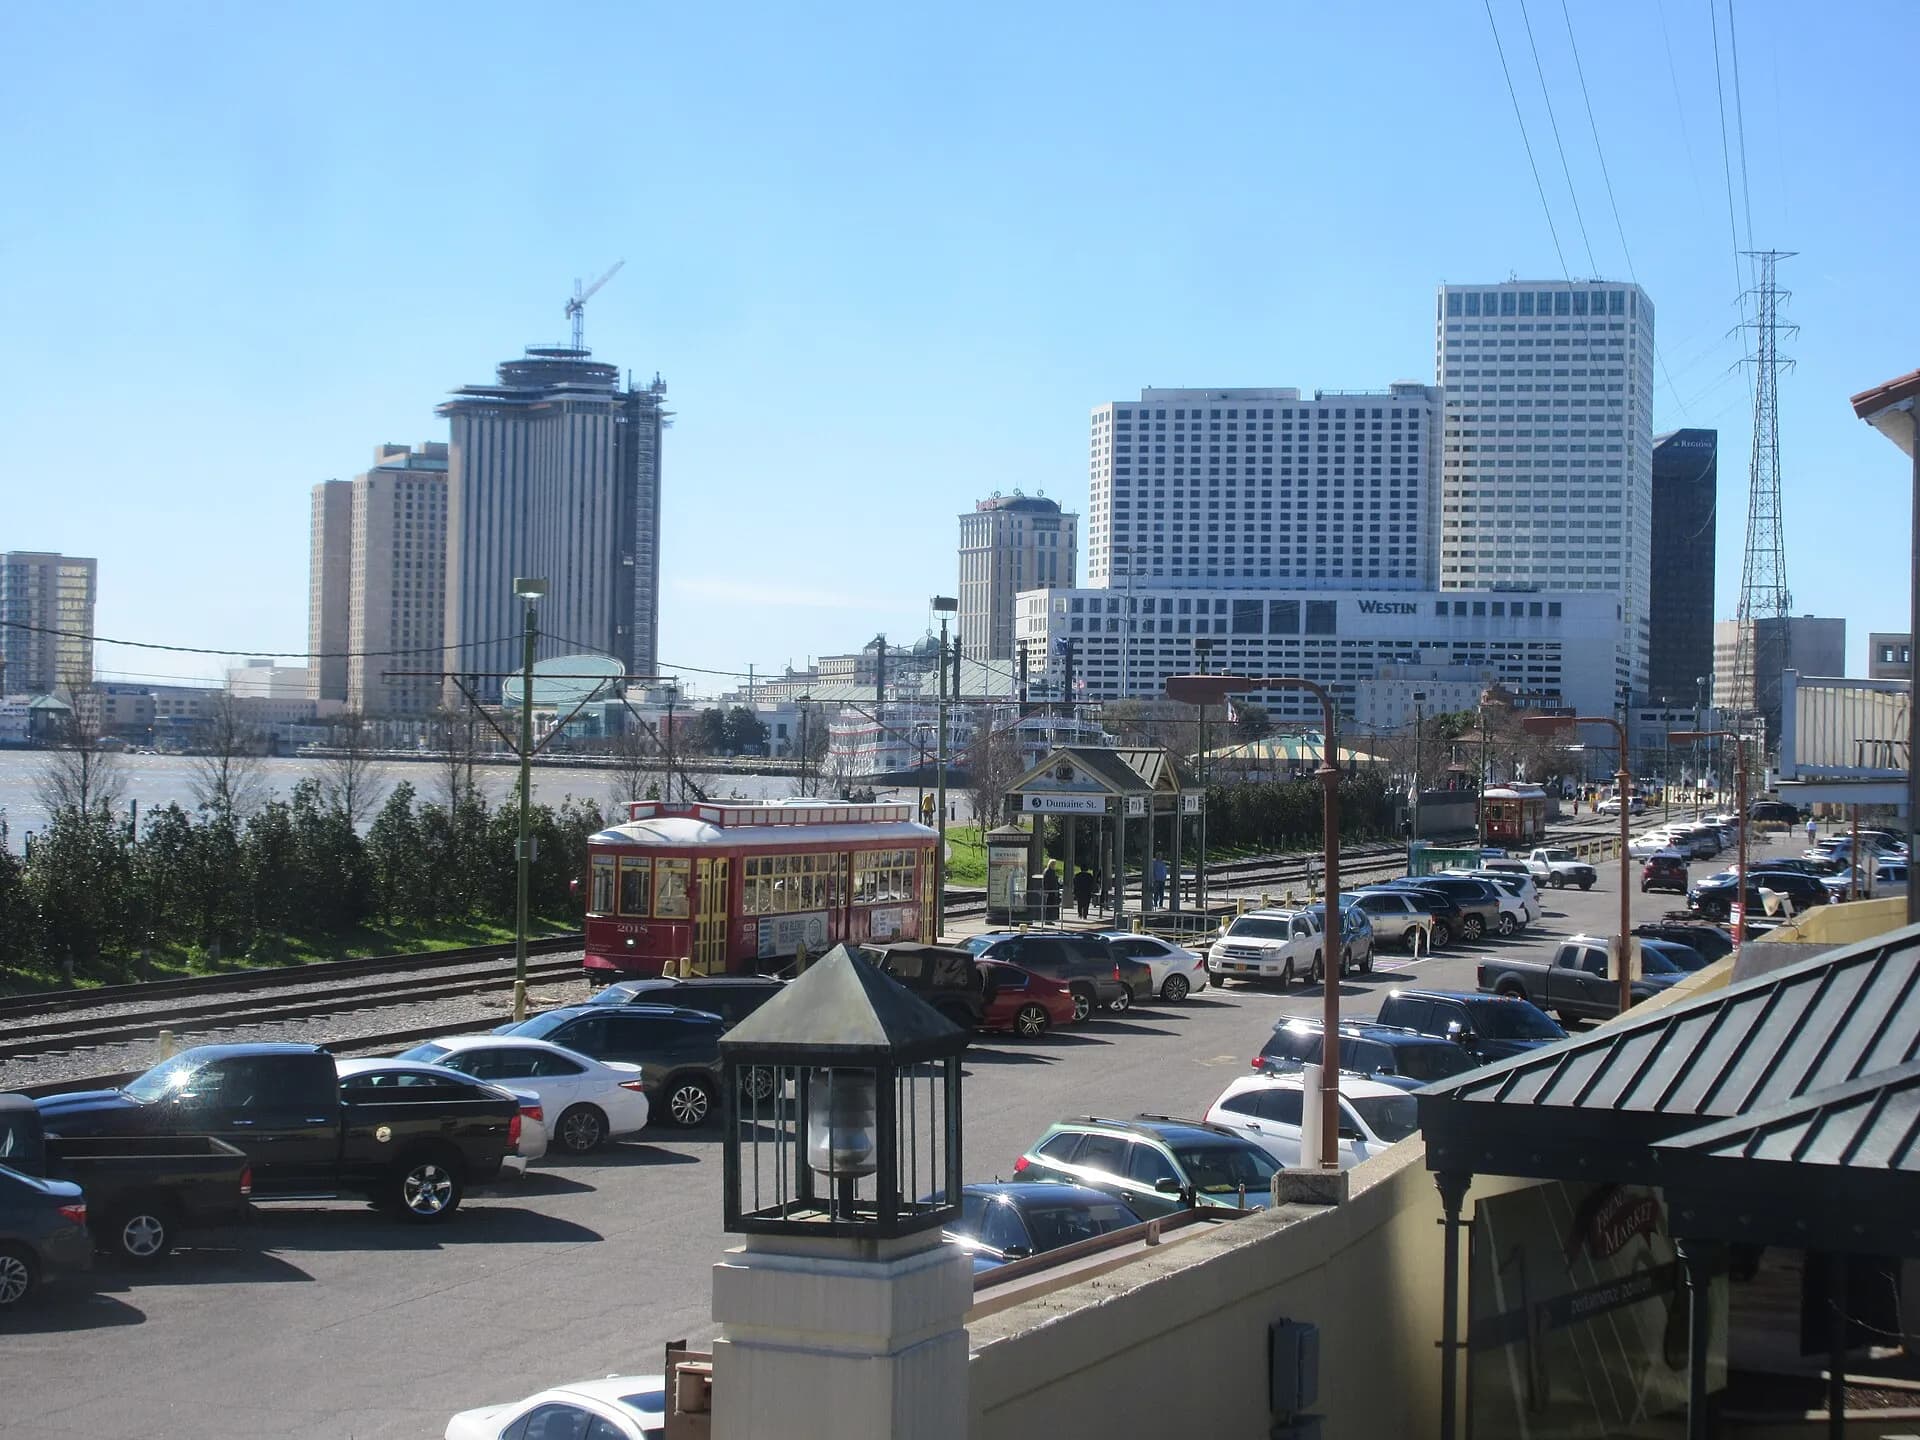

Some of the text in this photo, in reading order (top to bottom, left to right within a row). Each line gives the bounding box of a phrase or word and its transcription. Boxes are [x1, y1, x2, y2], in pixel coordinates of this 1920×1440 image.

[1358, 600, 1417, 614] WESTIN
[1046, 799, 1084, 809] Dumaine
[1086, 799, 1097, 809] St.
[617, 923, 648, 933] 2018
[1605, 1201, 1653, 1255] MARKET
